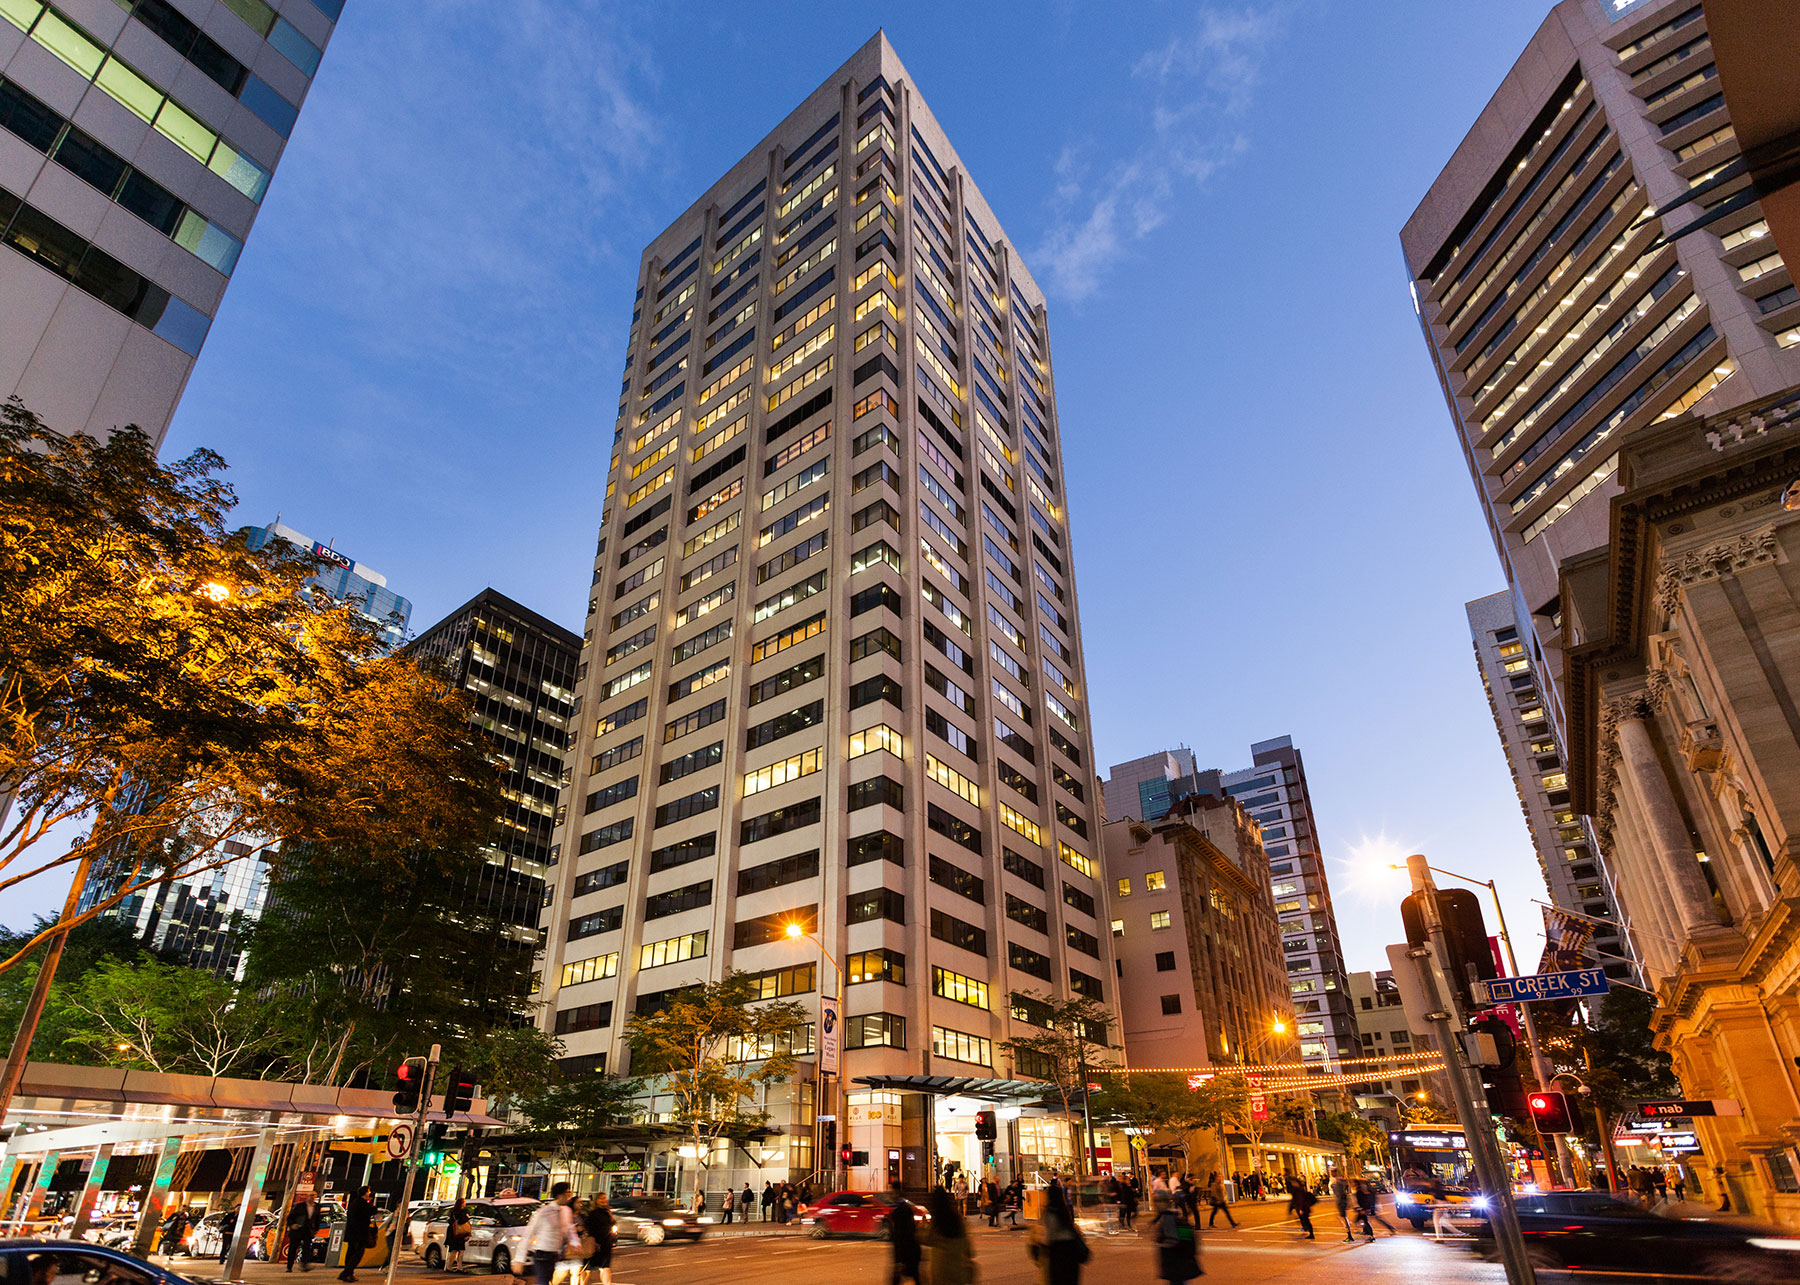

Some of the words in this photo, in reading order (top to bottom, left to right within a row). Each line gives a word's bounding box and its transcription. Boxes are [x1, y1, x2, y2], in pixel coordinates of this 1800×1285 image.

[321, 546, 351, 567] BDO
[1515, 974, 1570, 994] CREEK
[1579, 971, 1600, 987] ST
[1535, 990, 1547, 999] 97
[1571, 987, 1583, 996] 99
[1658, 1104, 1684, 1114] nab
